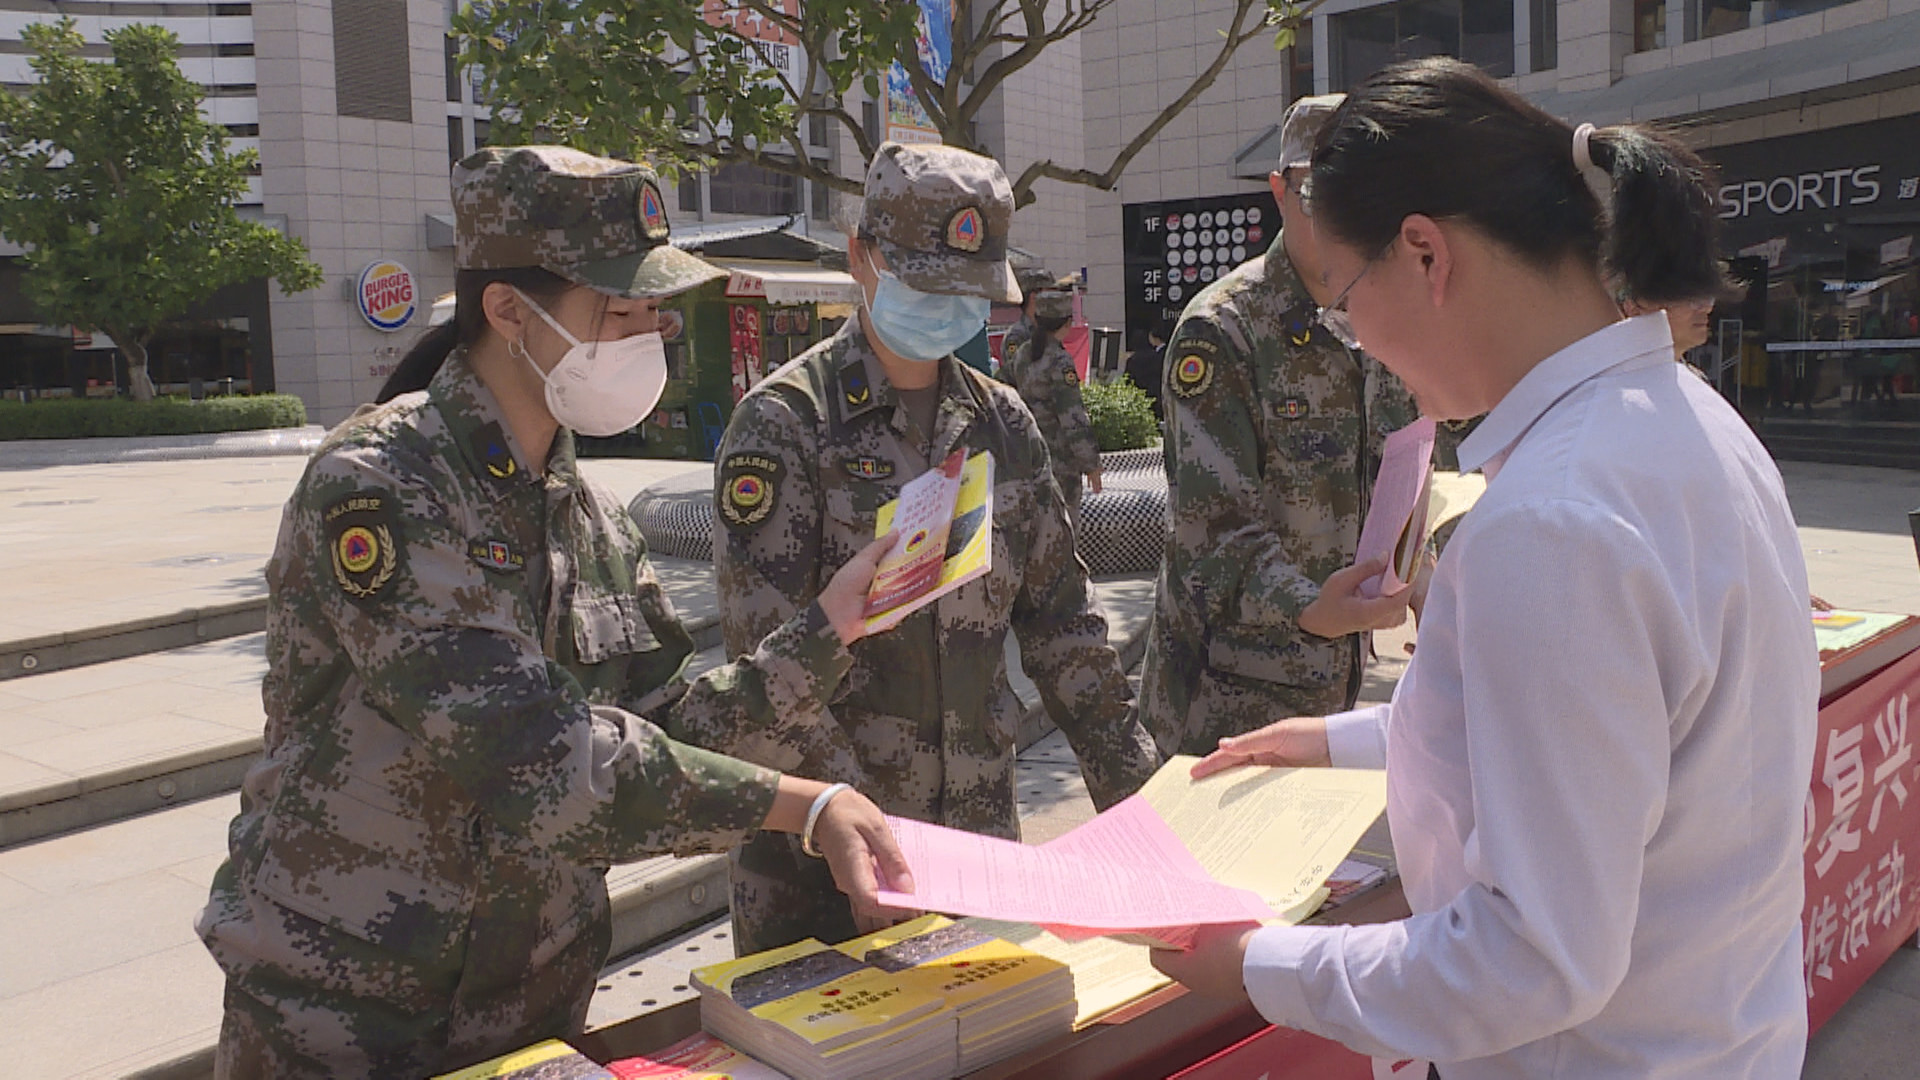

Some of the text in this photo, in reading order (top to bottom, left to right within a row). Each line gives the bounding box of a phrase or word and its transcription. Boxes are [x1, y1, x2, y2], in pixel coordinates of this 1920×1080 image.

[1717, 165, 1881, 219] SPORTS
[1144, 216, 1161, 233] 1F
[364, 273, 411, 298] BURGER
[1143, 269, 1162, 285] 2F
[367, 285, 413, 315] KING
[1144, 287, 1162, 302] 3F
[1803, 692, 1920, 879] 复兴
